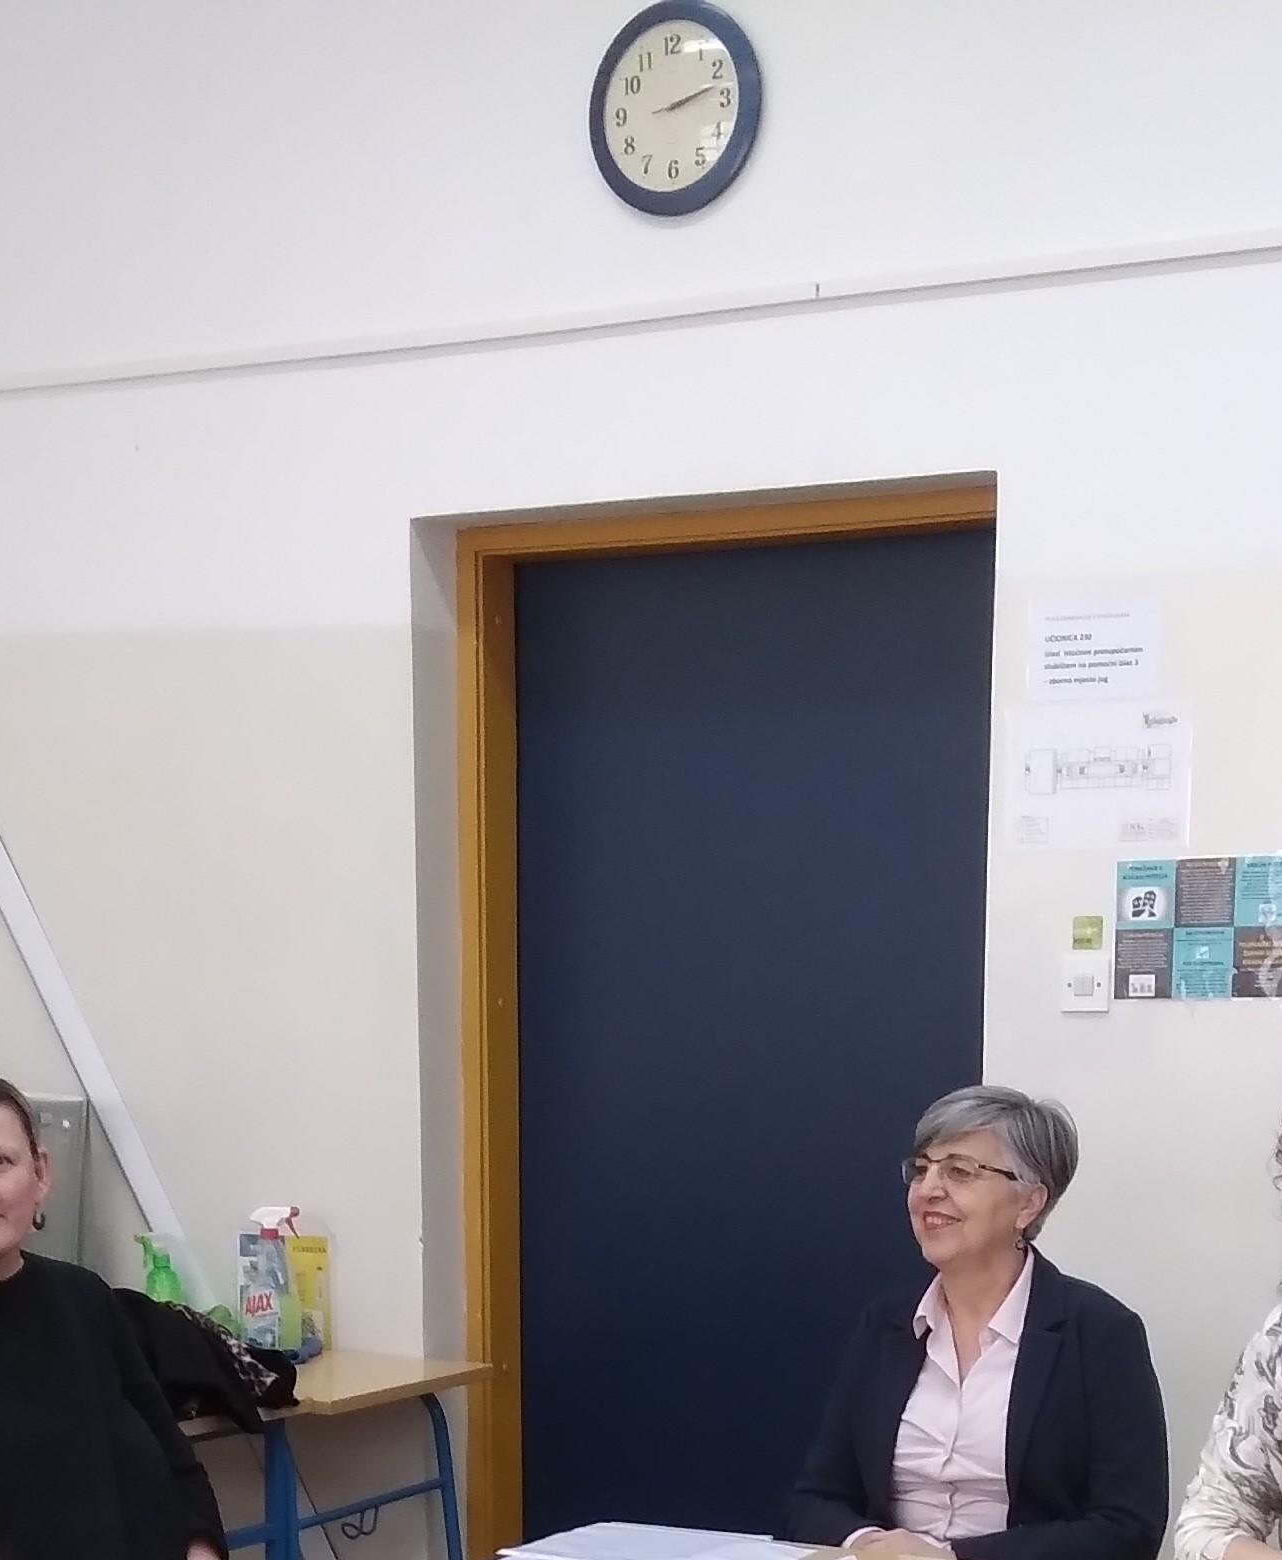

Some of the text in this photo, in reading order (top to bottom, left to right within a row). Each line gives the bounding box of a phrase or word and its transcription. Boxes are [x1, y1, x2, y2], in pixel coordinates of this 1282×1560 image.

[663, 34, 682, 56] 12
[638, 52, 653, 72] 11
[711, 59, 724, 79] 2
[623, 75, 641, 95] 10
[719, 88, 731, 108] 3
[615, 107, 627, 127] 9
[711, 121, 722, 141] 4
[623, 135, 635, 155] 8
[642, 154, 654, 175] 7
[694, 147, 707, 166] 5
[668, 159, 679, 179] 6
[245, 1292, 273, 1317] AJAX
